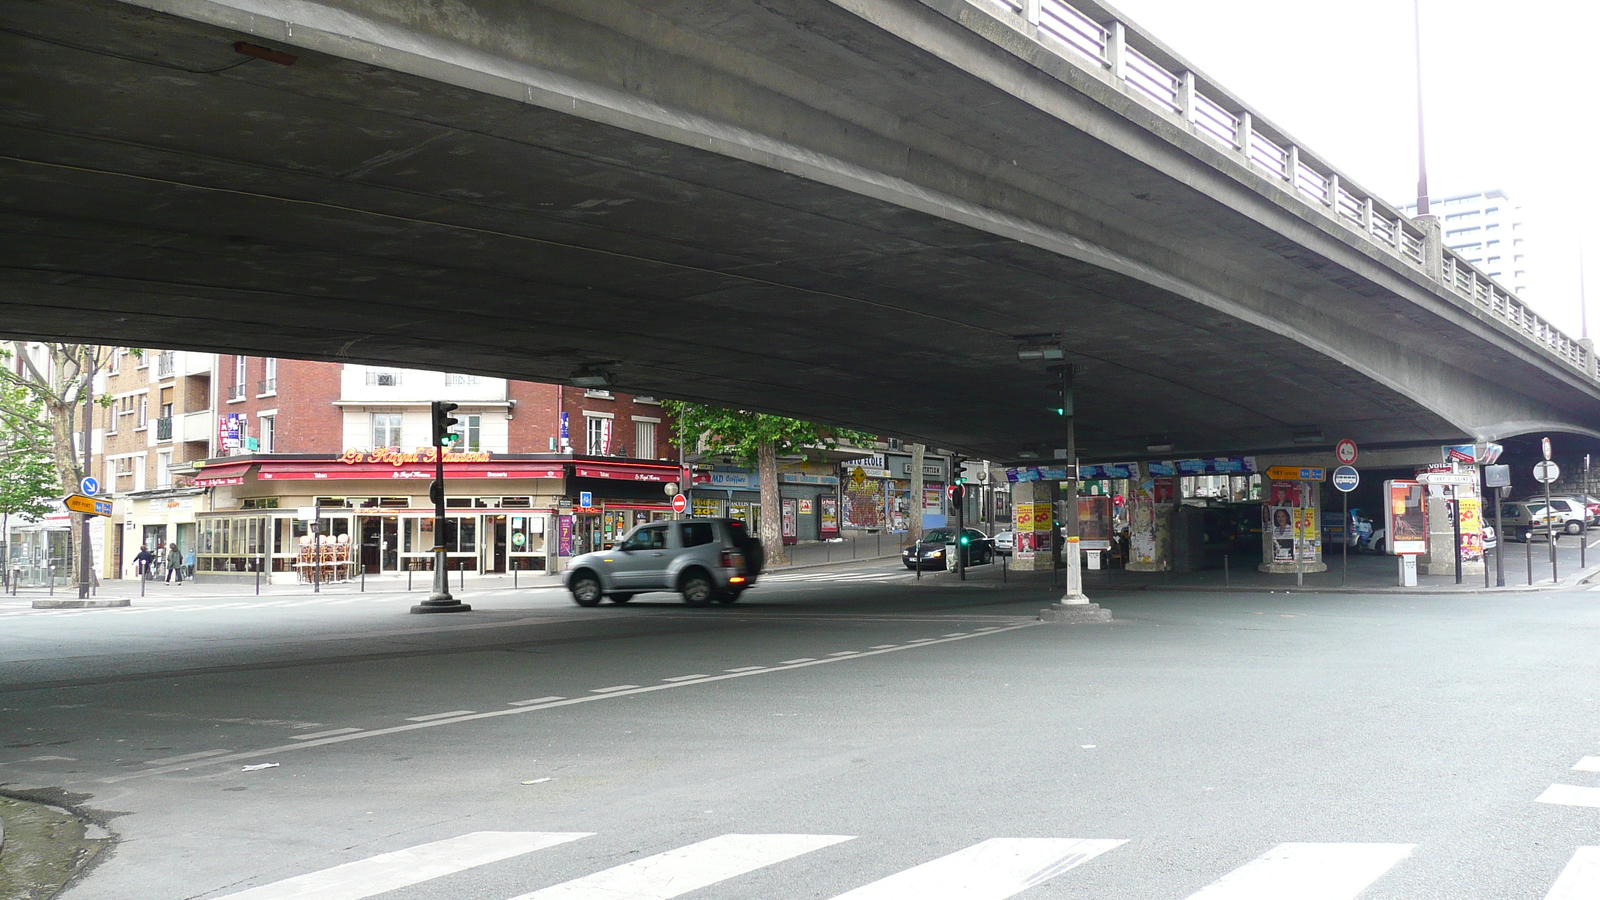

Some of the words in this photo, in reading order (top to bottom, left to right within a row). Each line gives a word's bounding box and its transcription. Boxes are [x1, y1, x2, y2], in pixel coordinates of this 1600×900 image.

[337, 447, 363, 464] Le
[368, 447, 419, 467] Royal
[864, 457, 883, 467] ECOLE
[712, 474, 724, 482] MD
